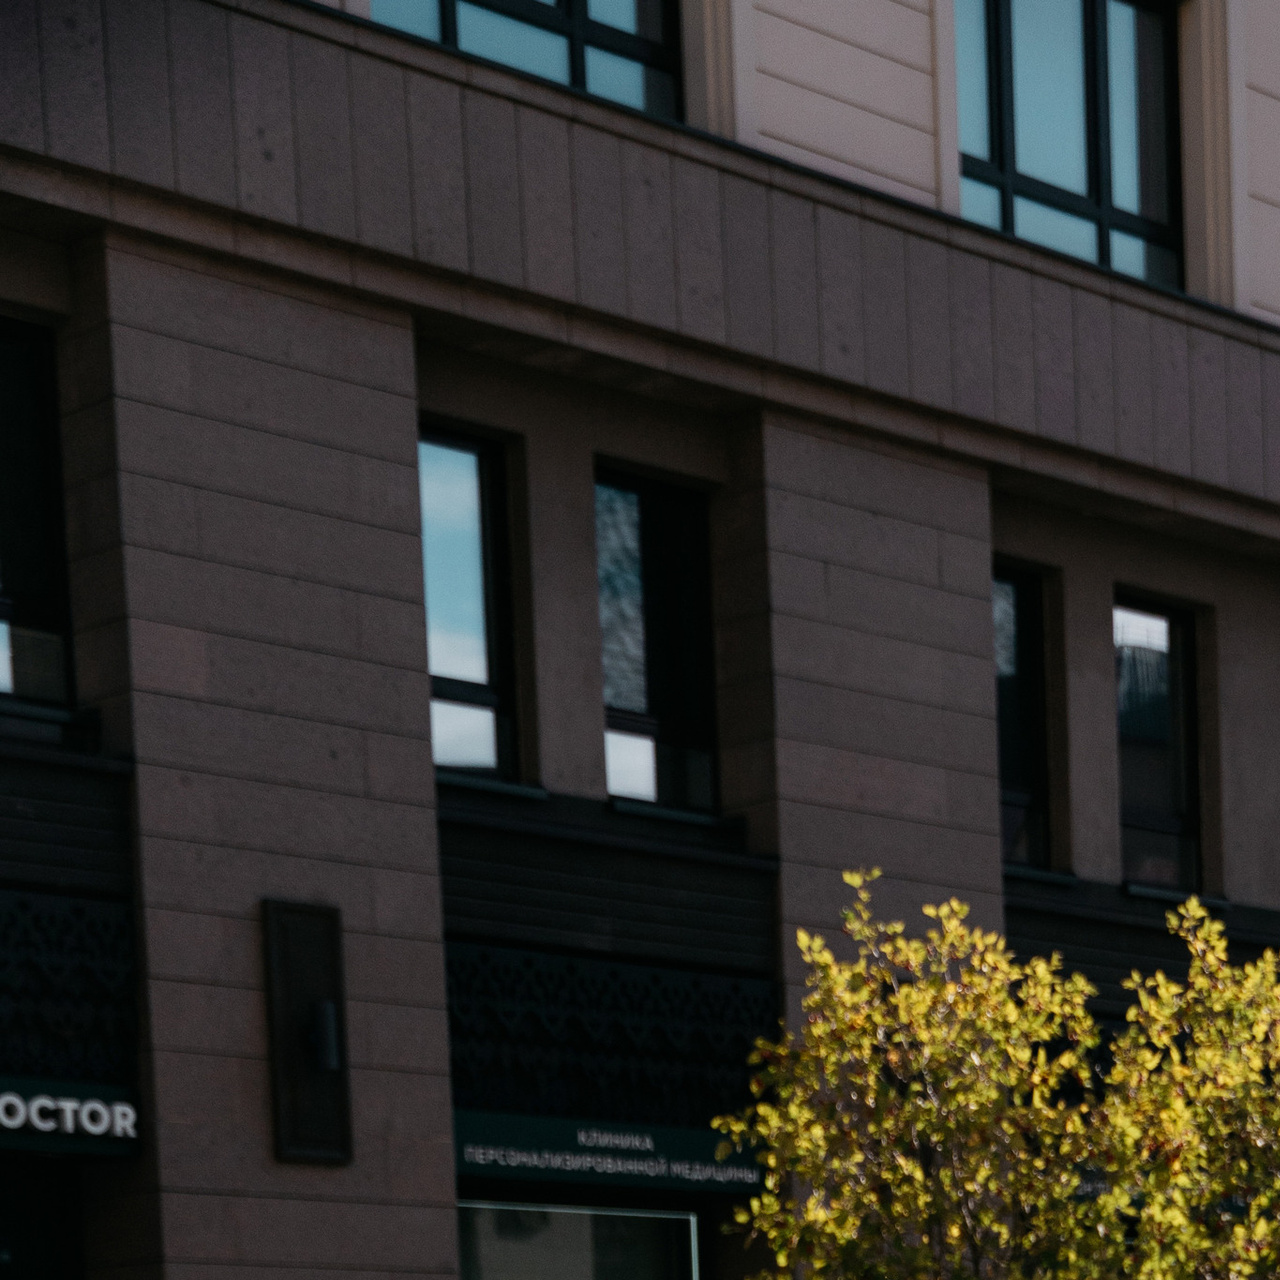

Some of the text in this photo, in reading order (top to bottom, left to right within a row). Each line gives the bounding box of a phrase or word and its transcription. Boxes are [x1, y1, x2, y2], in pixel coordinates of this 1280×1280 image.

[0, 1091, 138, 1139] OCTOR
[577, 1128, 655, 1152] КЛИНИКА
[463, 1143, 760, 1183] ПЕРСОНАЛИЗИРОВАННОЙ МЕДИЦИНЫ
